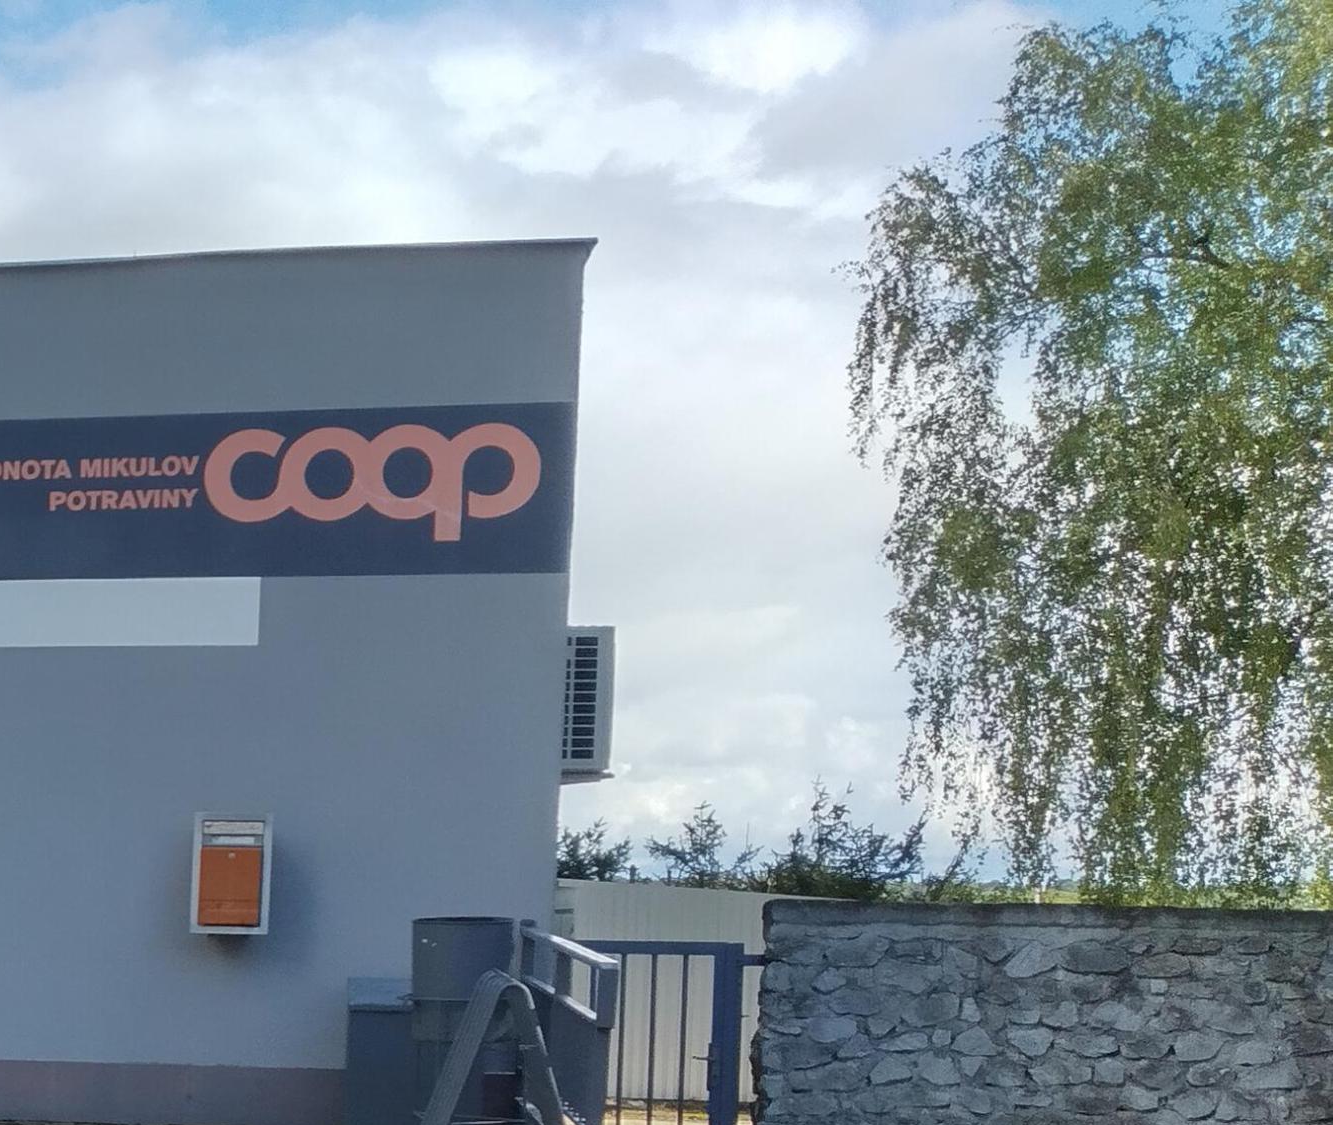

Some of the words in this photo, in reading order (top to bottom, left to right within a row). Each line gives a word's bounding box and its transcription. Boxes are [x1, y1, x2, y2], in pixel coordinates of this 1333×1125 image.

[80, 455, 200, 478] MIKULOV
[203, 422, 541, 542] coop
[48, 487, 199, 511] POTRAVINY
